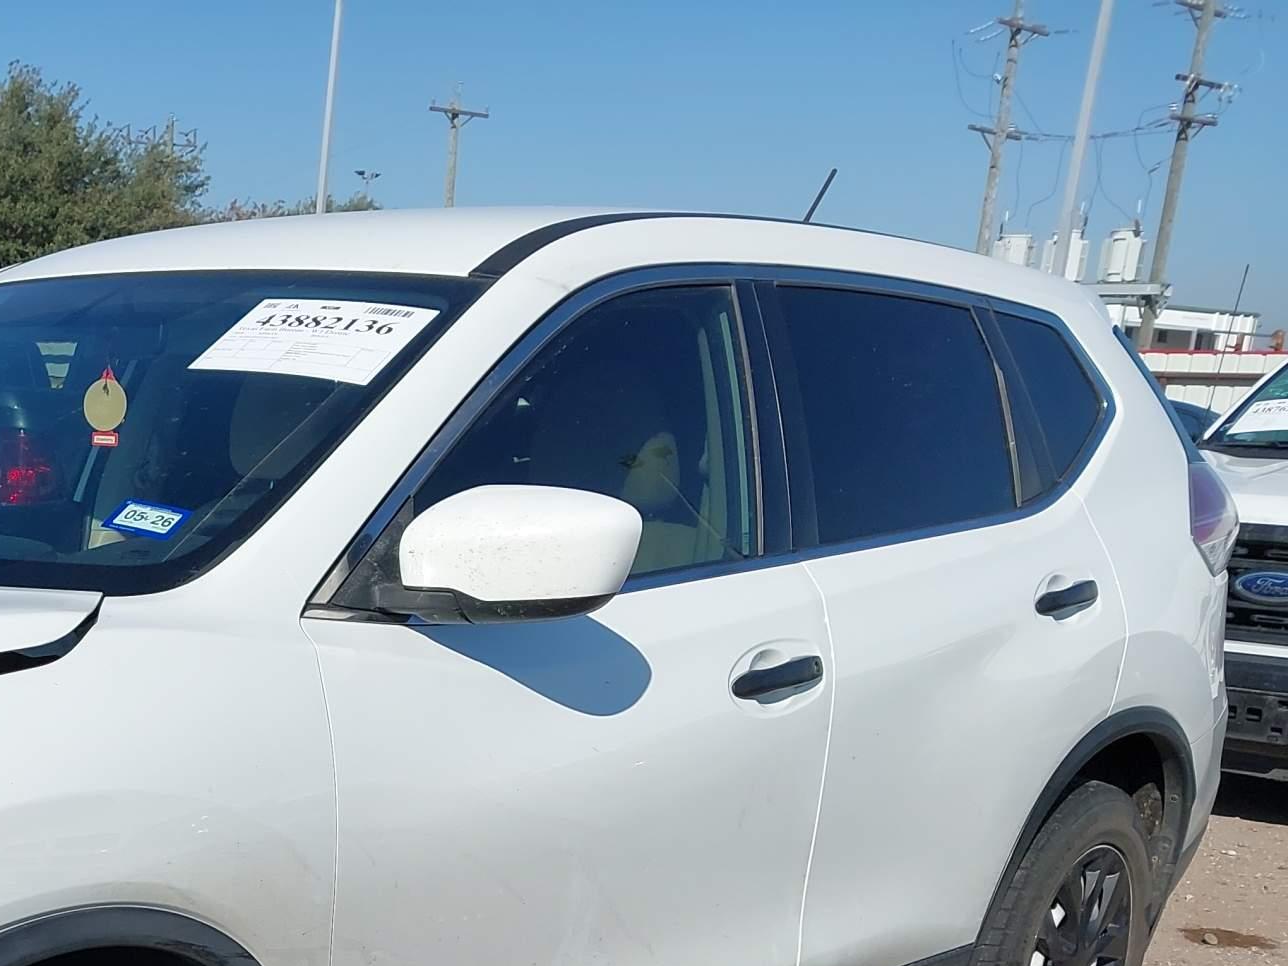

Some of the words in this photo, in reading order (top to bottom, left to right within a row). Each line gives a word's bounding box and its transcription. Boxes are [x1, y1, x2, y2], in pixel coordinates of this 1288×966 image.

[256, 313, 400, 335] 43882136
[124, 509, 147, 522] 05
[150, 515, 174, 527] 26
